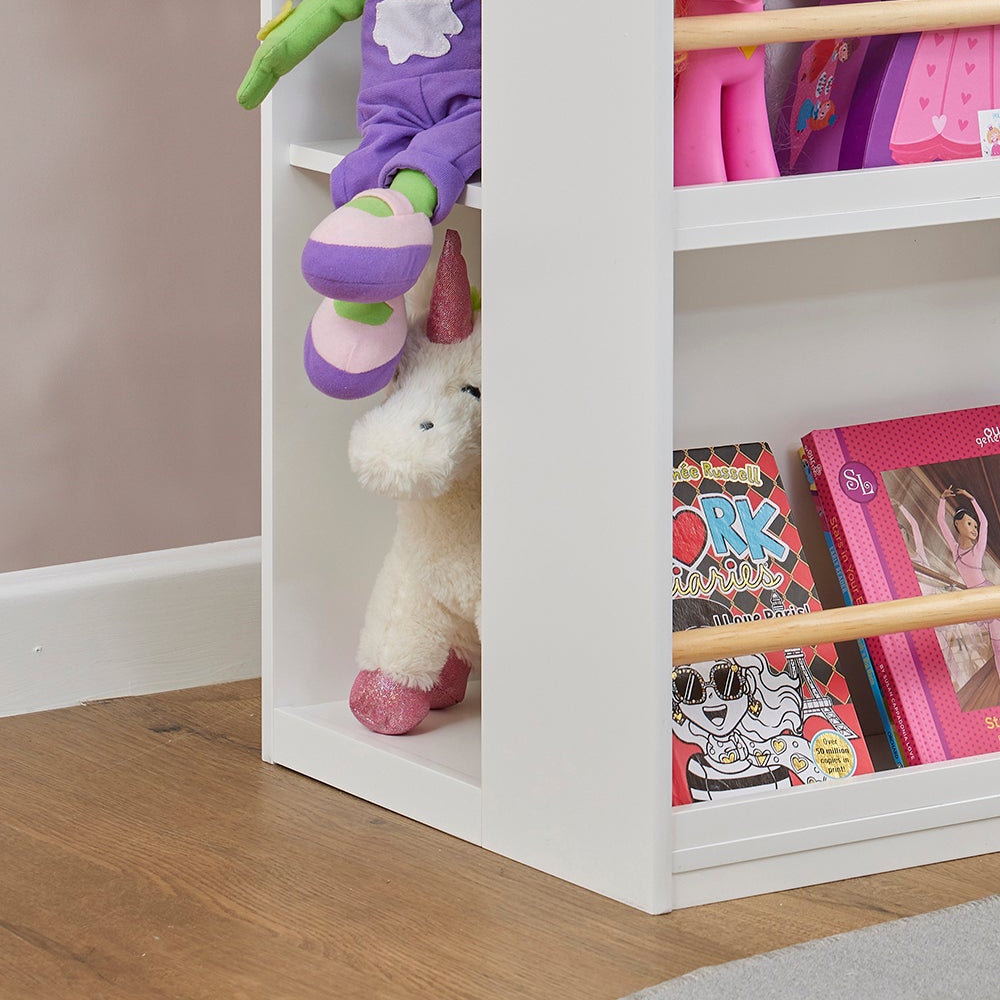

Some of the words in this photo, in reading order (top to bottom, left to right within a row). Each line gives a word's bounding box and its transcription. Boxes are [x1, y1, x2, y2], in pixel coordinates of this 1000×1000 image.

[672, 462, 700, 480] née
[701, 462, 762, 486] Russell
[829, 516, 844, 549] Stars
[840, 549, 848, 564] in
[846, 565, 861, 593] Your
[672, 561, 781, 596] iaries
[879, 663, 886, 674] BY
[883, 674, 894, 697] SUSAN
[906, 741, 915, 761] LOVE
[815, 747, 825, 755] 50
[825, 747, 850, 755] million
[820, 757, 842, 765] copies
